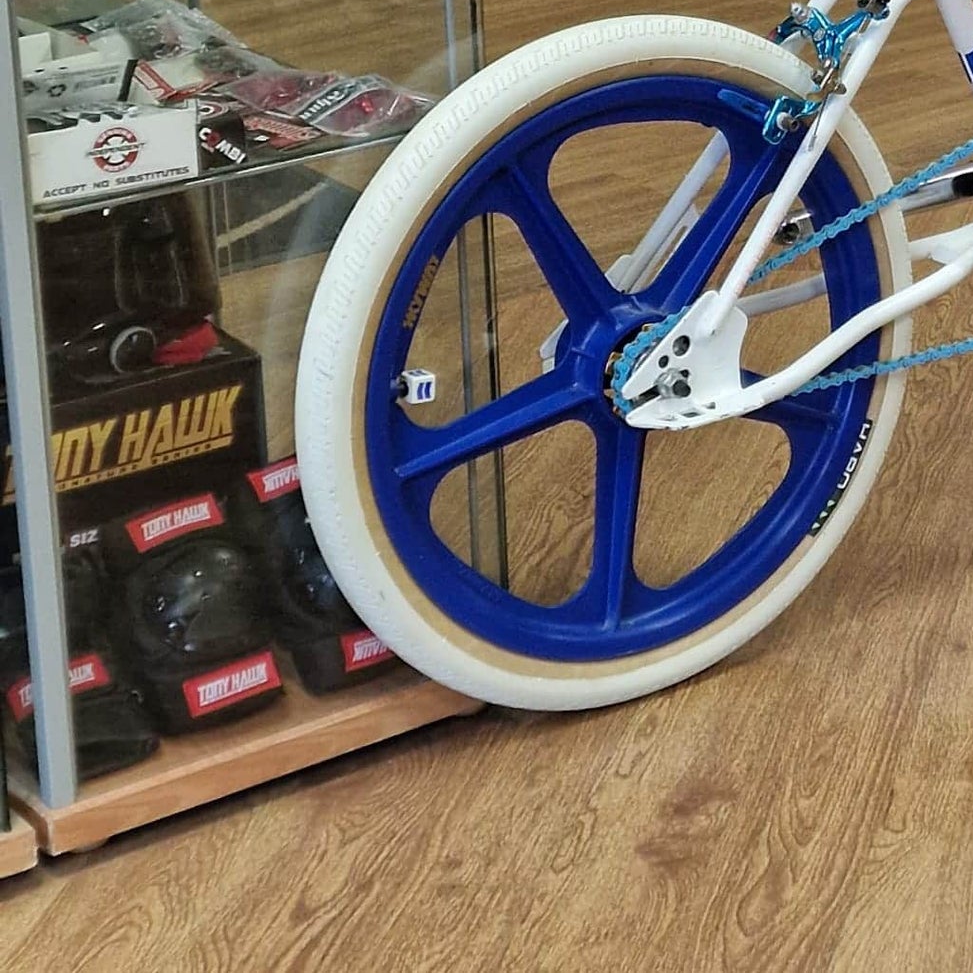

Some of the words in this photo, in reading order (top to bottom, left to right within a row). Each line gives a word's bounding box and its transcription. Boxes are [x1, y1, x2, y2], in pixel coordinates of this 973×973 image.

[42, 184, 87, 199] ACCEPT
[93, 179, 109, 189] NO
[116, 166, 190, 186] SUBSTITUTES
[117, 385, 242, 469] HAWK
[70, 529, 98, 548] SIZ
[140, 515, 173, 542] TONY
[173, 502, 211, 528] HAWK
[197, 678, 230, 707] TONY
[230, 662, 268, 693] HAWK
